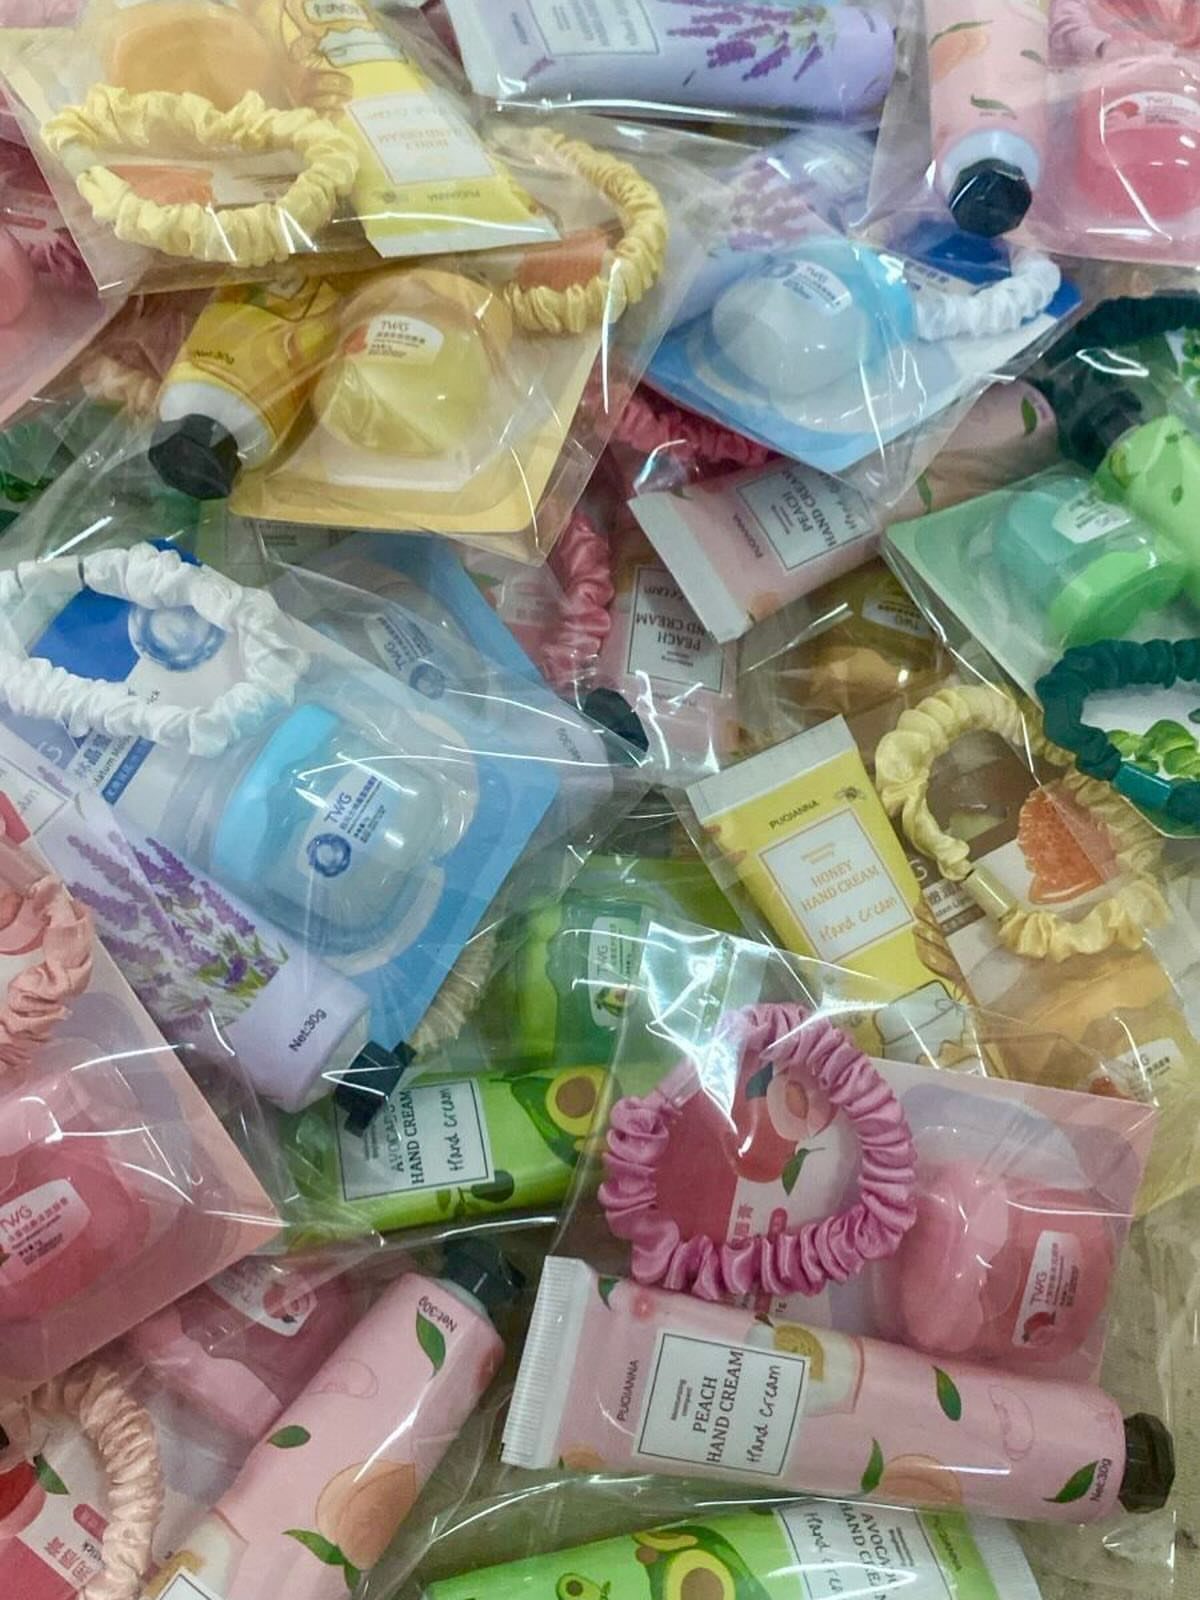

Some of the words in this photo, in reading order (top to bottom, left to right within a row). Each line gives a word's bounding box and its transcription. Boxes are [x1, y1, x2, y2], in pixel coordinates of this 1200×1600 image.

[782, 490, 815, 534] PEACH
[811, 507, 837, 548] HAND
[634, 612, 685, 632] CREAM
[657, 631, 701, 652] PEACH
[323, 791, 353, 823] TWG
[800, 885, 839, 912] HAND
[837, 864, 881, 895] CREAM
[810, 858, 853, 888] HONEY
[596, 943, 610, 977] TWG
[288, 1008, 328, 1053] Net:30g
[399, 1090, 419, 1138] CREAM
[406, 1140, 426, 1185] HAND
[445, 1131, 466, 1172] Hand
[1029, 1271, 1049, 1307] TWG
[418, 1295, 458, 1333] Net:30g
[616, 1359, 640, 1422] PUQIANNA
[692, 1375, 719, 1434] PEACH
[706, 1415, 731, 1464] HAND
[719, 1350, 745, 1414] CREAM
[747, 1423, 769, 1464] Hand
[759, 1364, 782, 1418] Cream
